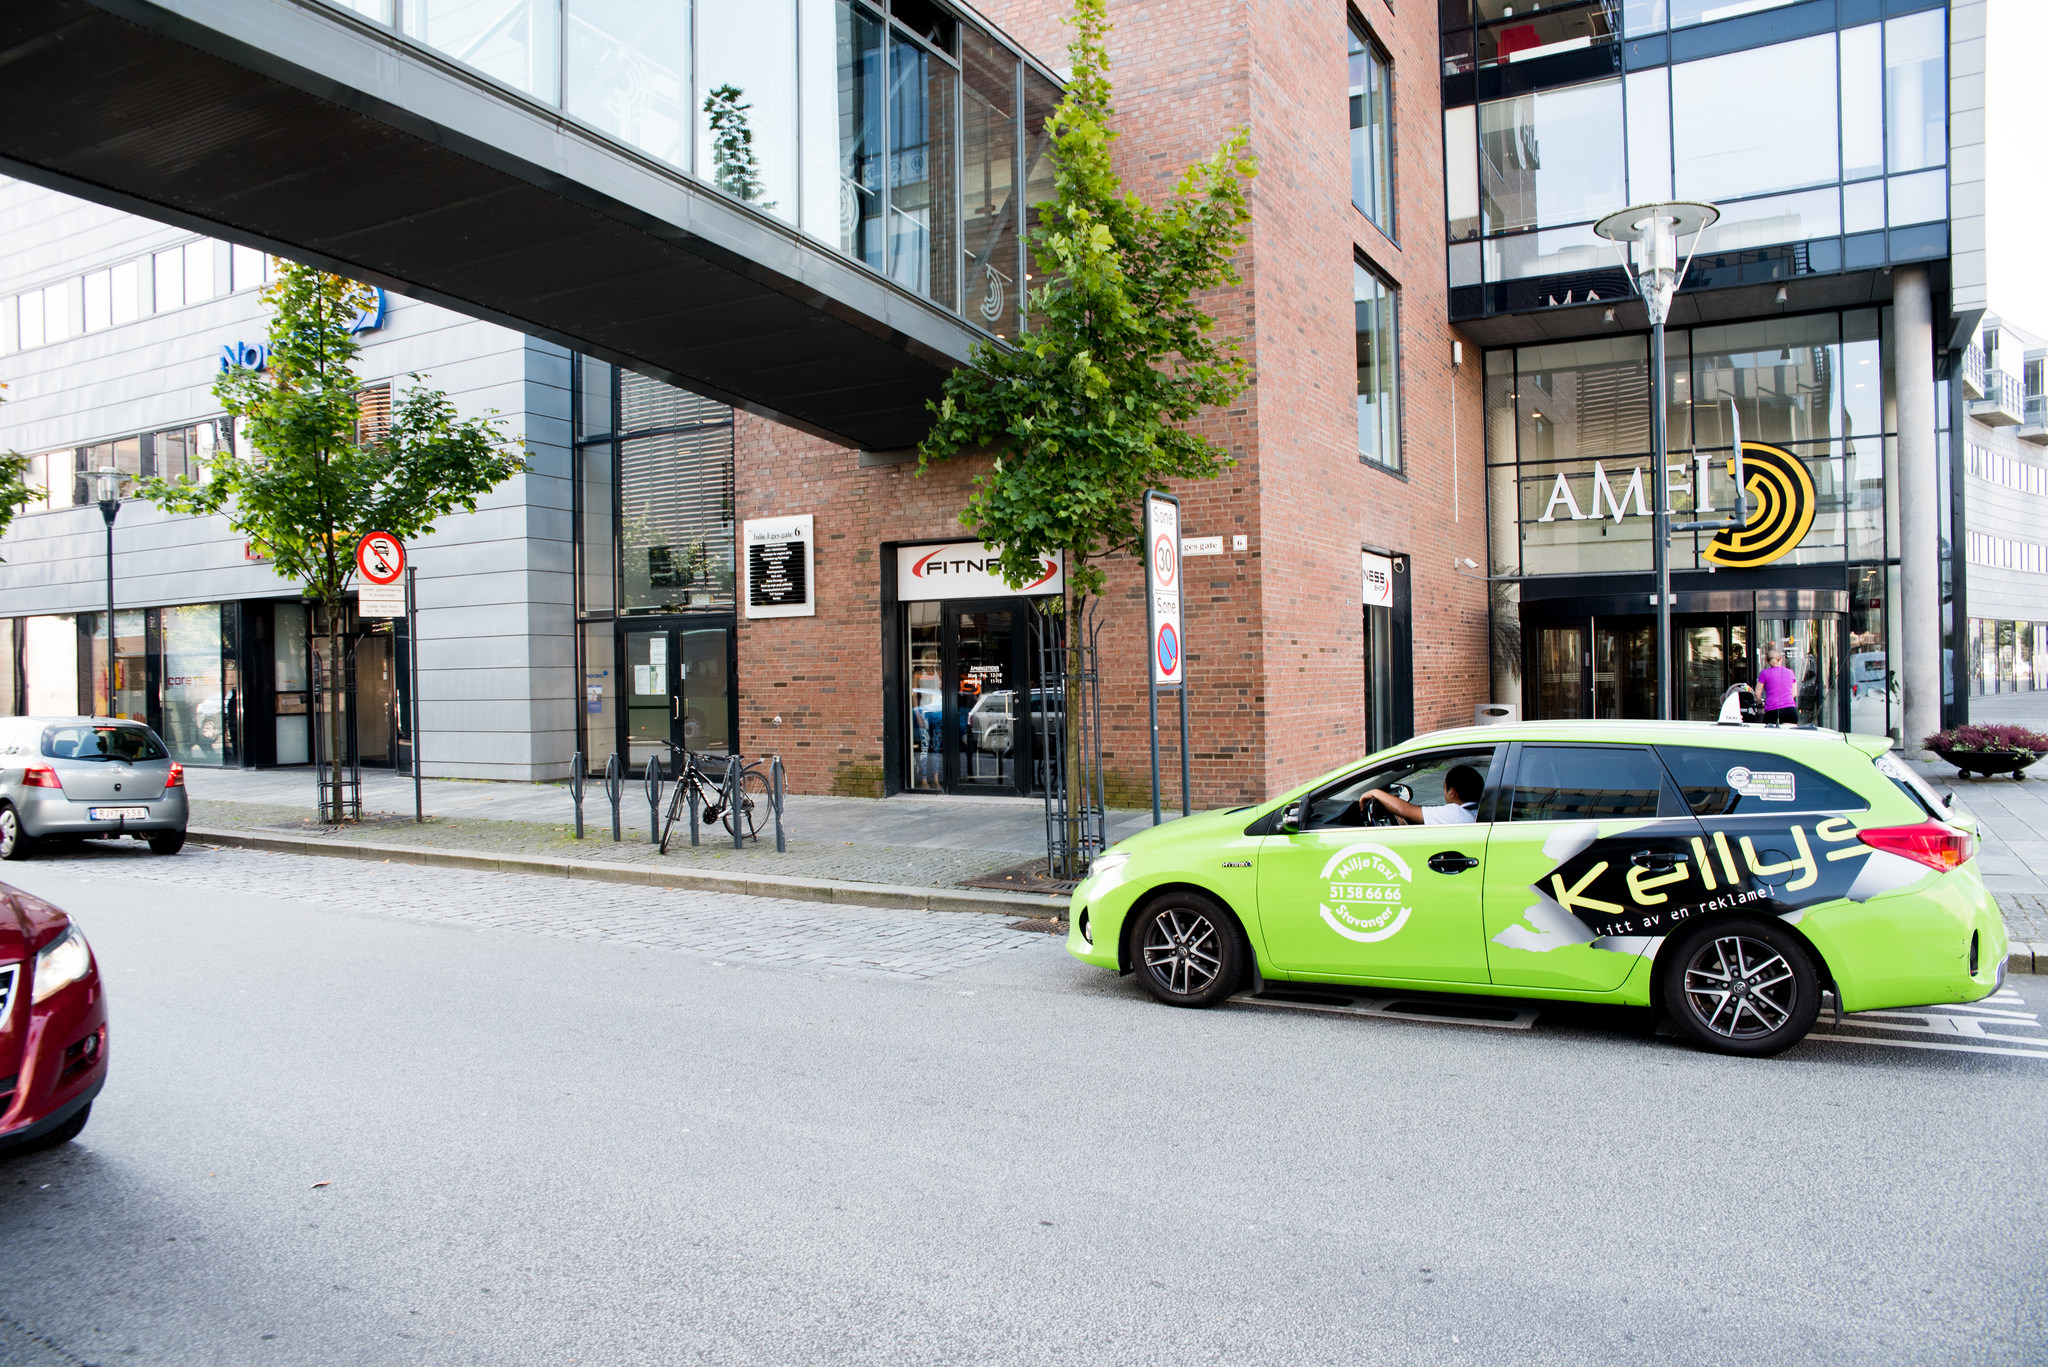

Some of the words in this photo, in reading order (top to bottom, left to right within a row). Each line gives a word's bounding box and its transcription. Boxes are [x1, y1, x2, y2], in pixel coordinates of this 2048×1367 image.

[1538, 454, 1716, 524] AMFI
[1153, 506, 1173, 526] Sone
[781, 531, 793, 539] gate
[794, 526, 801, 537] 6
[1182, 543, 1198, 552] ges
[1199, 541, 1218, 551] gate
[926, 555, 1041, 576] FITNE
[1158, 546, 1172, 573] 30
[1157, 597, 1177, 615] Sone
[1337, 856, 1371, 880] Miljø
[1371, 855, 1398, 881] Taxi
[1550, 817, 1875, 915] Kellys
[1329, 885, 1344, 898] 51
[1346, 886, 1363, 899] 58
[1365, 887, 1382, 900] 66
[1384, 887, 1402, 901] 66
[1335, 903, 1393, 928] Stavanger
[1642, 913, 1660, 928] av
[1670, 906, 1690, 921] en
[1698, 883, 1776, 914] reklame!
